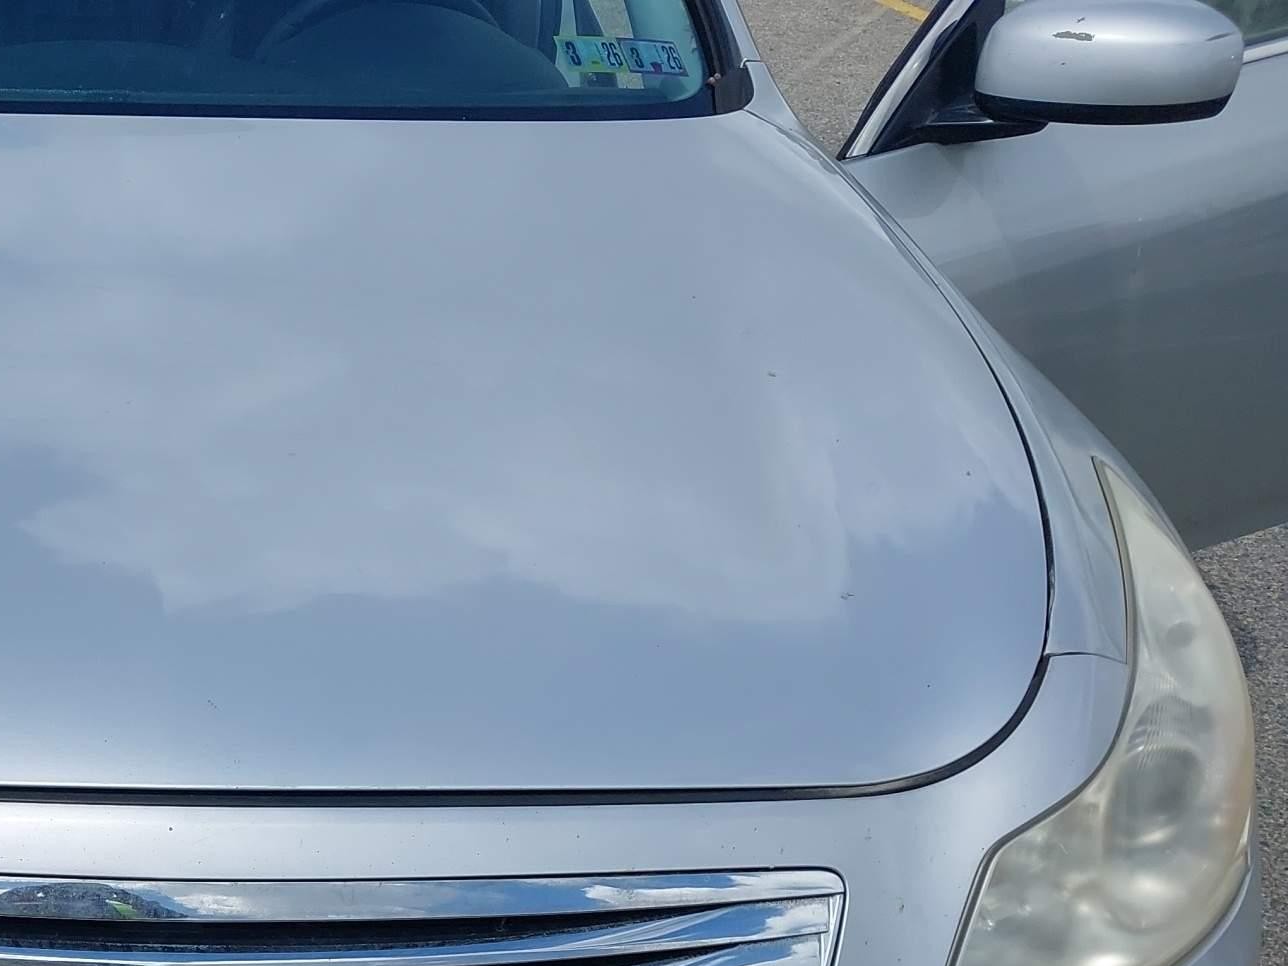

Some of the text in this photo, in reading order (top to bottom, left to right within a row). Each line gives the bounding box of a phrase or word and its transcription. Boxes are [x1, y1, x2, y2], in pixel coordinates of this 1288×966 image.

[565, 41, 582, 66] 3
[601, 42, 624, 67] 26
[630, 47, 644, 69] 3
[661, 45, 682, 70] 26
